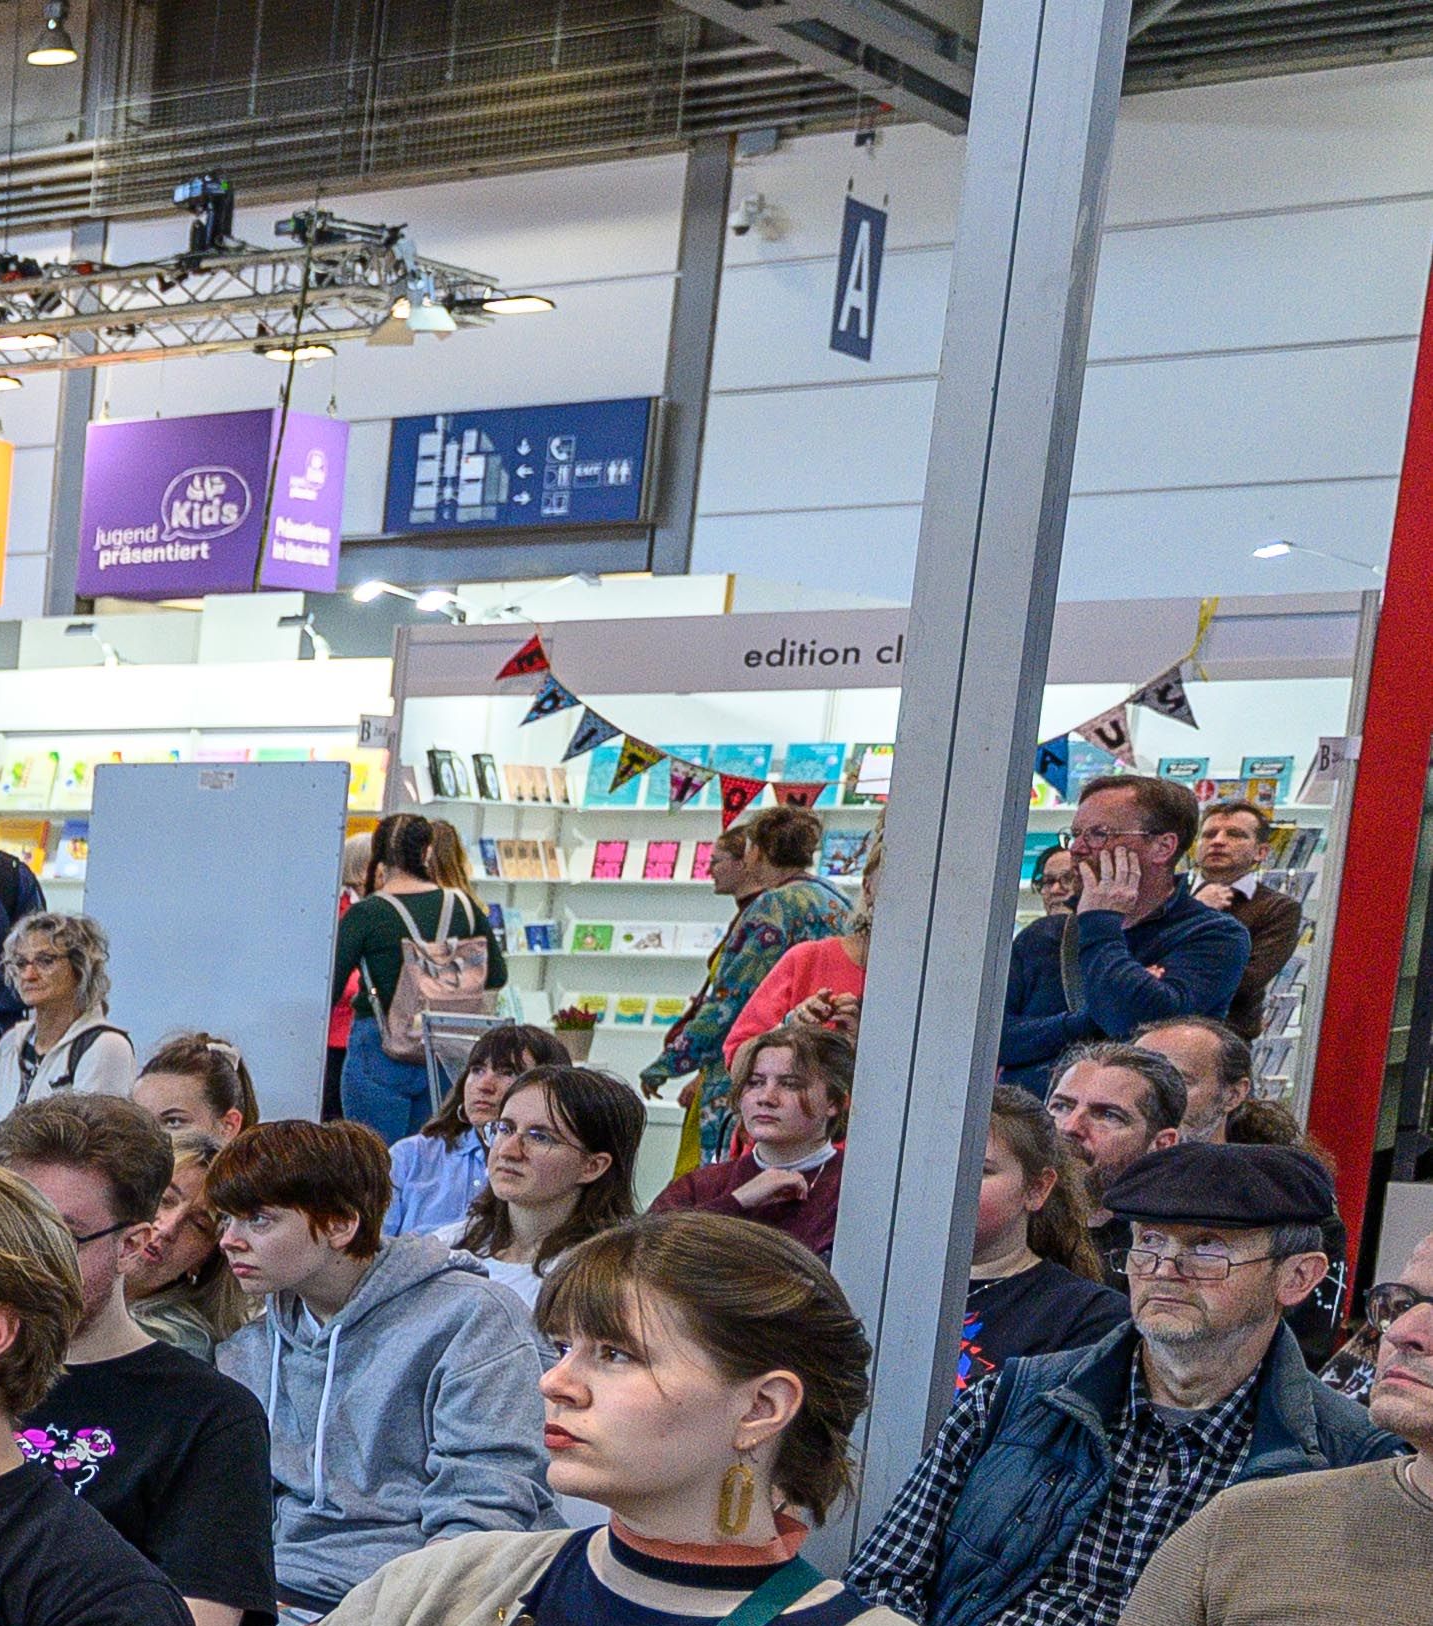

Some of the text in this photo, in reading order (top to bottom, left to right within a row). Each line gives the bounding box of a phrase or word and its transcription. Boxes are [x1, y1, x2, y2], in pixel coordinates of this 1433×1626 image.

[838, 220, 871, 340] A
[170, 500, 239, 529] Kids
[93, 523, 159, 550] jugend
[98, 541, 211, 570] präsentiert
[744, 638, 860, 668] edition
